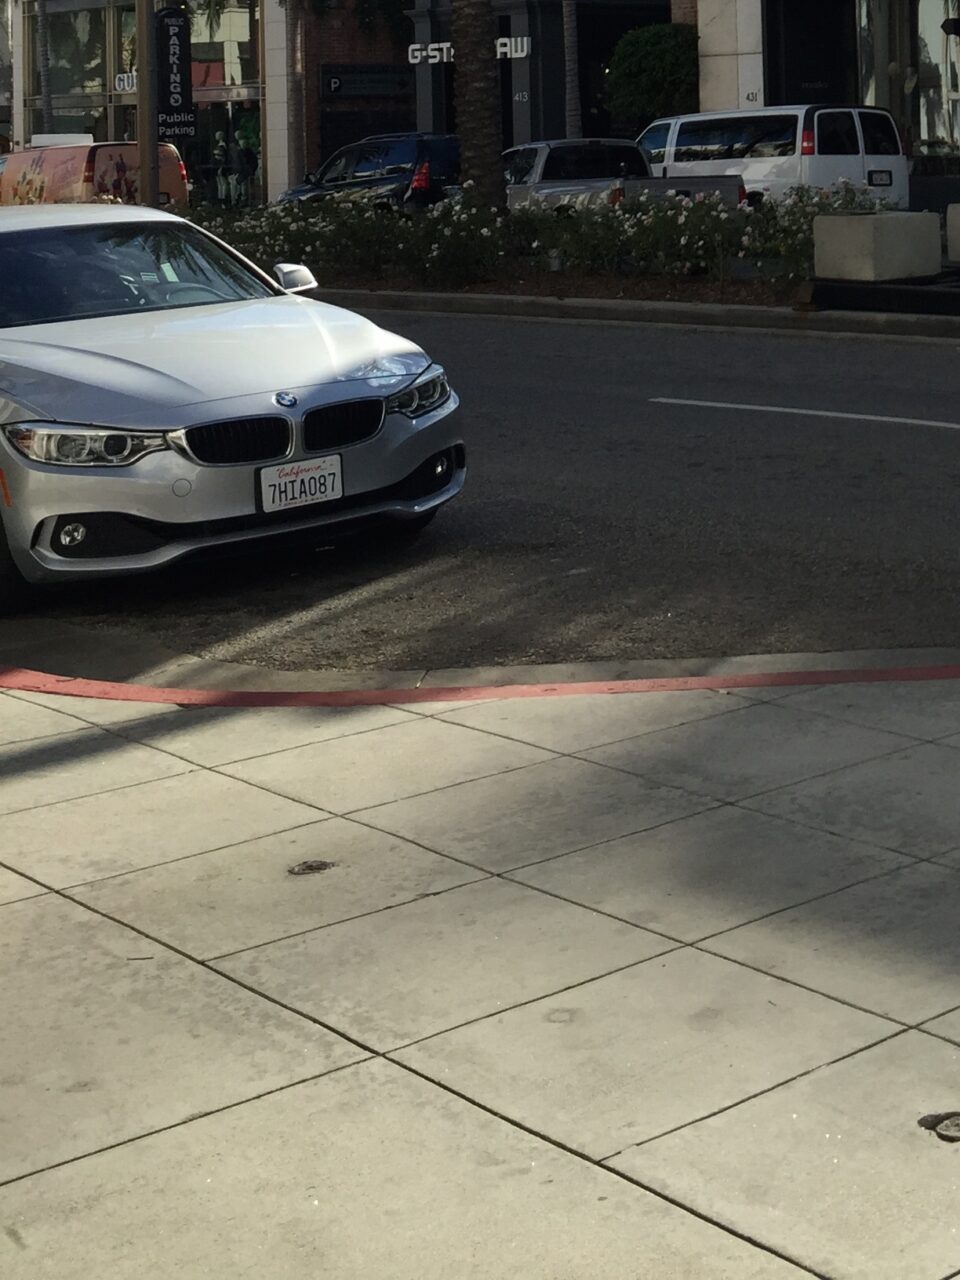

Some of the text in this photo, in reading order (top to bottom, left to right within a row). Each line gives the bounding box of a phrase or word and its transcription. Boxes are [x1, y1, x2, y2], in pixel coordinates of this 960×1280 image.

[164, 18, 184, 26] PUBLIC
[408, 42, 455, 64] G-ST
[169, 26, 181, 92] PARKING
[746, 92, 758, 102] 431
[158, 114, 195, 123] Public
[159, 126, 195, 136] Parking
[268, 472, 336, 504] 7HIA087
